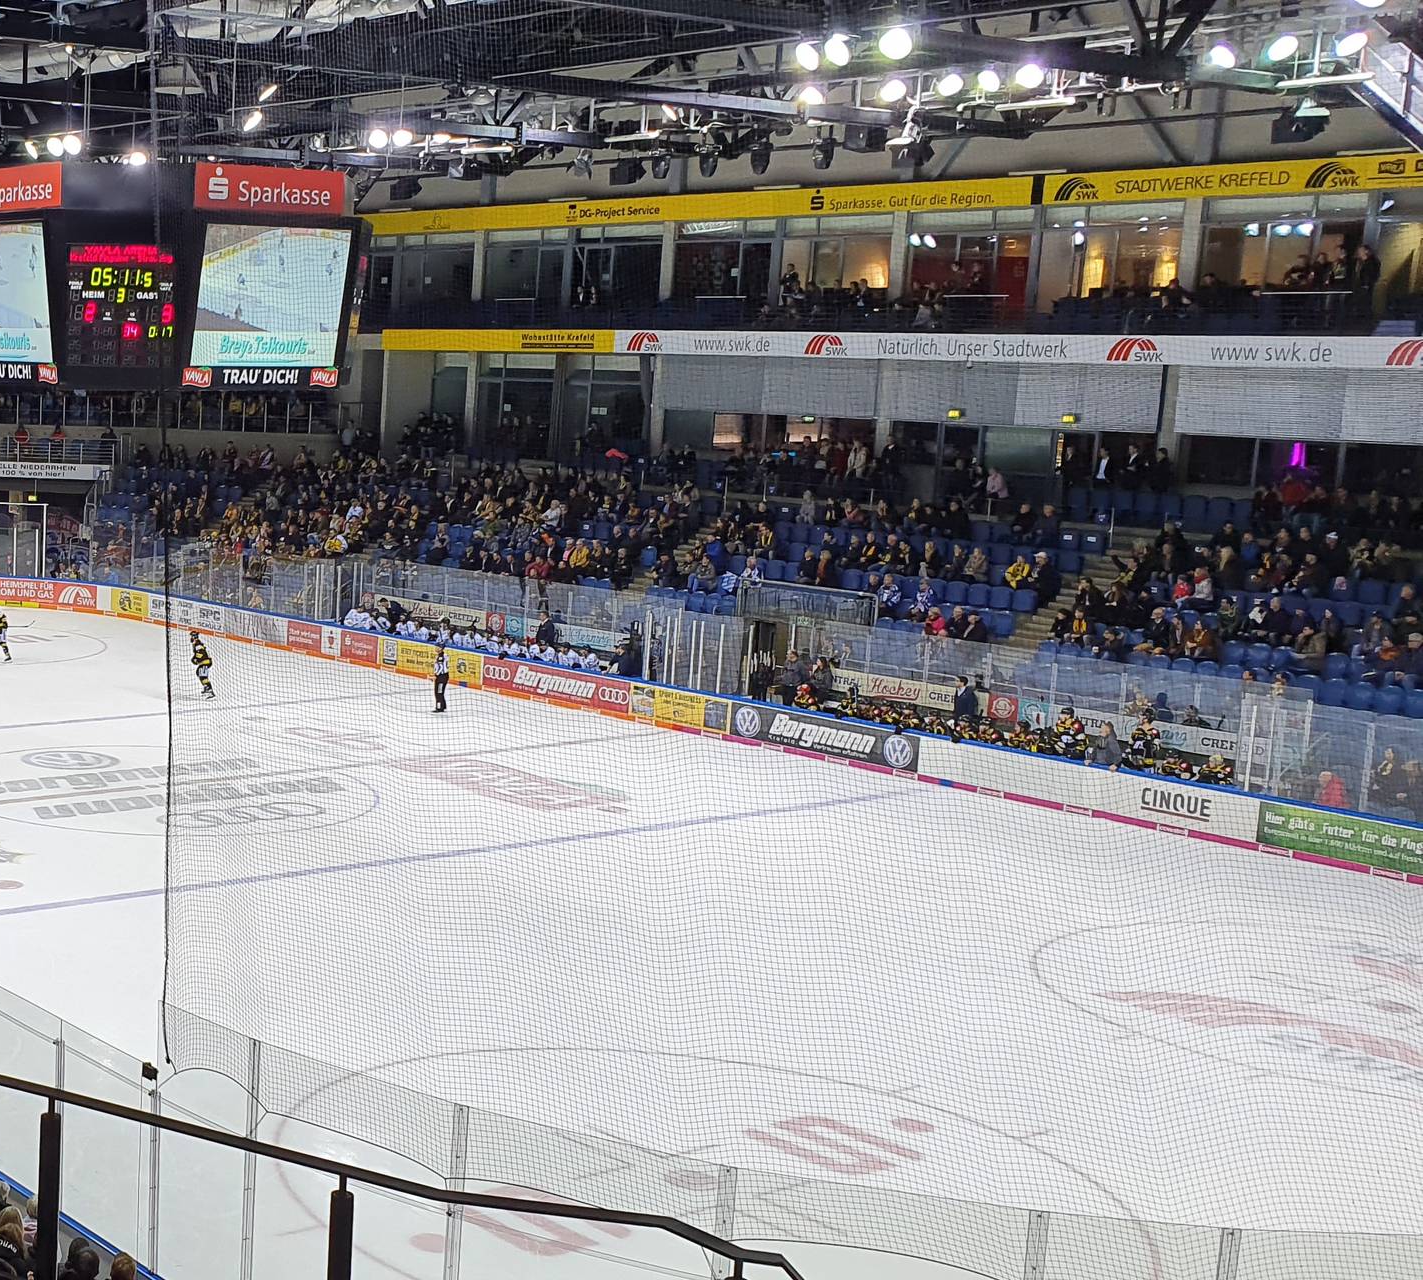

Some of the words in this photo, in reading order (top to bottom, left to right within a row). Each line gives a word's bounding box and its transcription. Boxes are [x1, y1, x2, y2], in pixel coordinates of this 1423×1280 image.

[1114, 175, 1213, 194] STADTWERKE
[1219, 171, 1290, 188] KREFELD
[1331, 175, 1361, 188] SWK
[238, 180, 331, 208] Sparkasse
[1075, 190, 1099, 200] SWK
[829, 198, 886, 212] Sparkasse.
[889, 195, 908, 207] Gut
[910, 193, 928, 207] für
[935, 193, 948, 205] die
[951, 193, 995, 208] Region.
[579, 207, 626, 219] DG-Project
[627, 205, 660, 216] Service
[82, 290, 105, 299] HEIM
[117, 287, 126, 303] 3
[136, 291, 159, 299] GAST
[694, 337, 770, 352] www.swk.de
[825, 346, 848, 356] SWK
[878, 338, 941, 356] Natürlich.
[947, 340, 988, 357] Unser
[993, 339, 1068, 358] Stadtwerk
[1134, 351, 1164, 362] SWK
[8, 365, 32, 380] DICH!
[262, 368, 300, 385] DICH!
[20, 463, 77, 472] NIEDERRHEIN
[1, 581, 38, 590] HEIMSPIEL
[40, 581, 54, 591] FÜR
[17, 589, 36, 598] UND
[37, 591, 54, 599] GAS
[77, 597, 96, 606] SWK
[199, 607, 221, 622] SPC
[513, 665, 596, 699] Borgmann
[870, 677, 922, 700] Hockey
[769, 713, 876, 754] Borgmann
[1141, 787, 1212, 818] CINQUE
[1265, 811, 1286, 826] Hier
[1362, 829, 1379, 842] für
[1381, 833, 1397, 847] die
